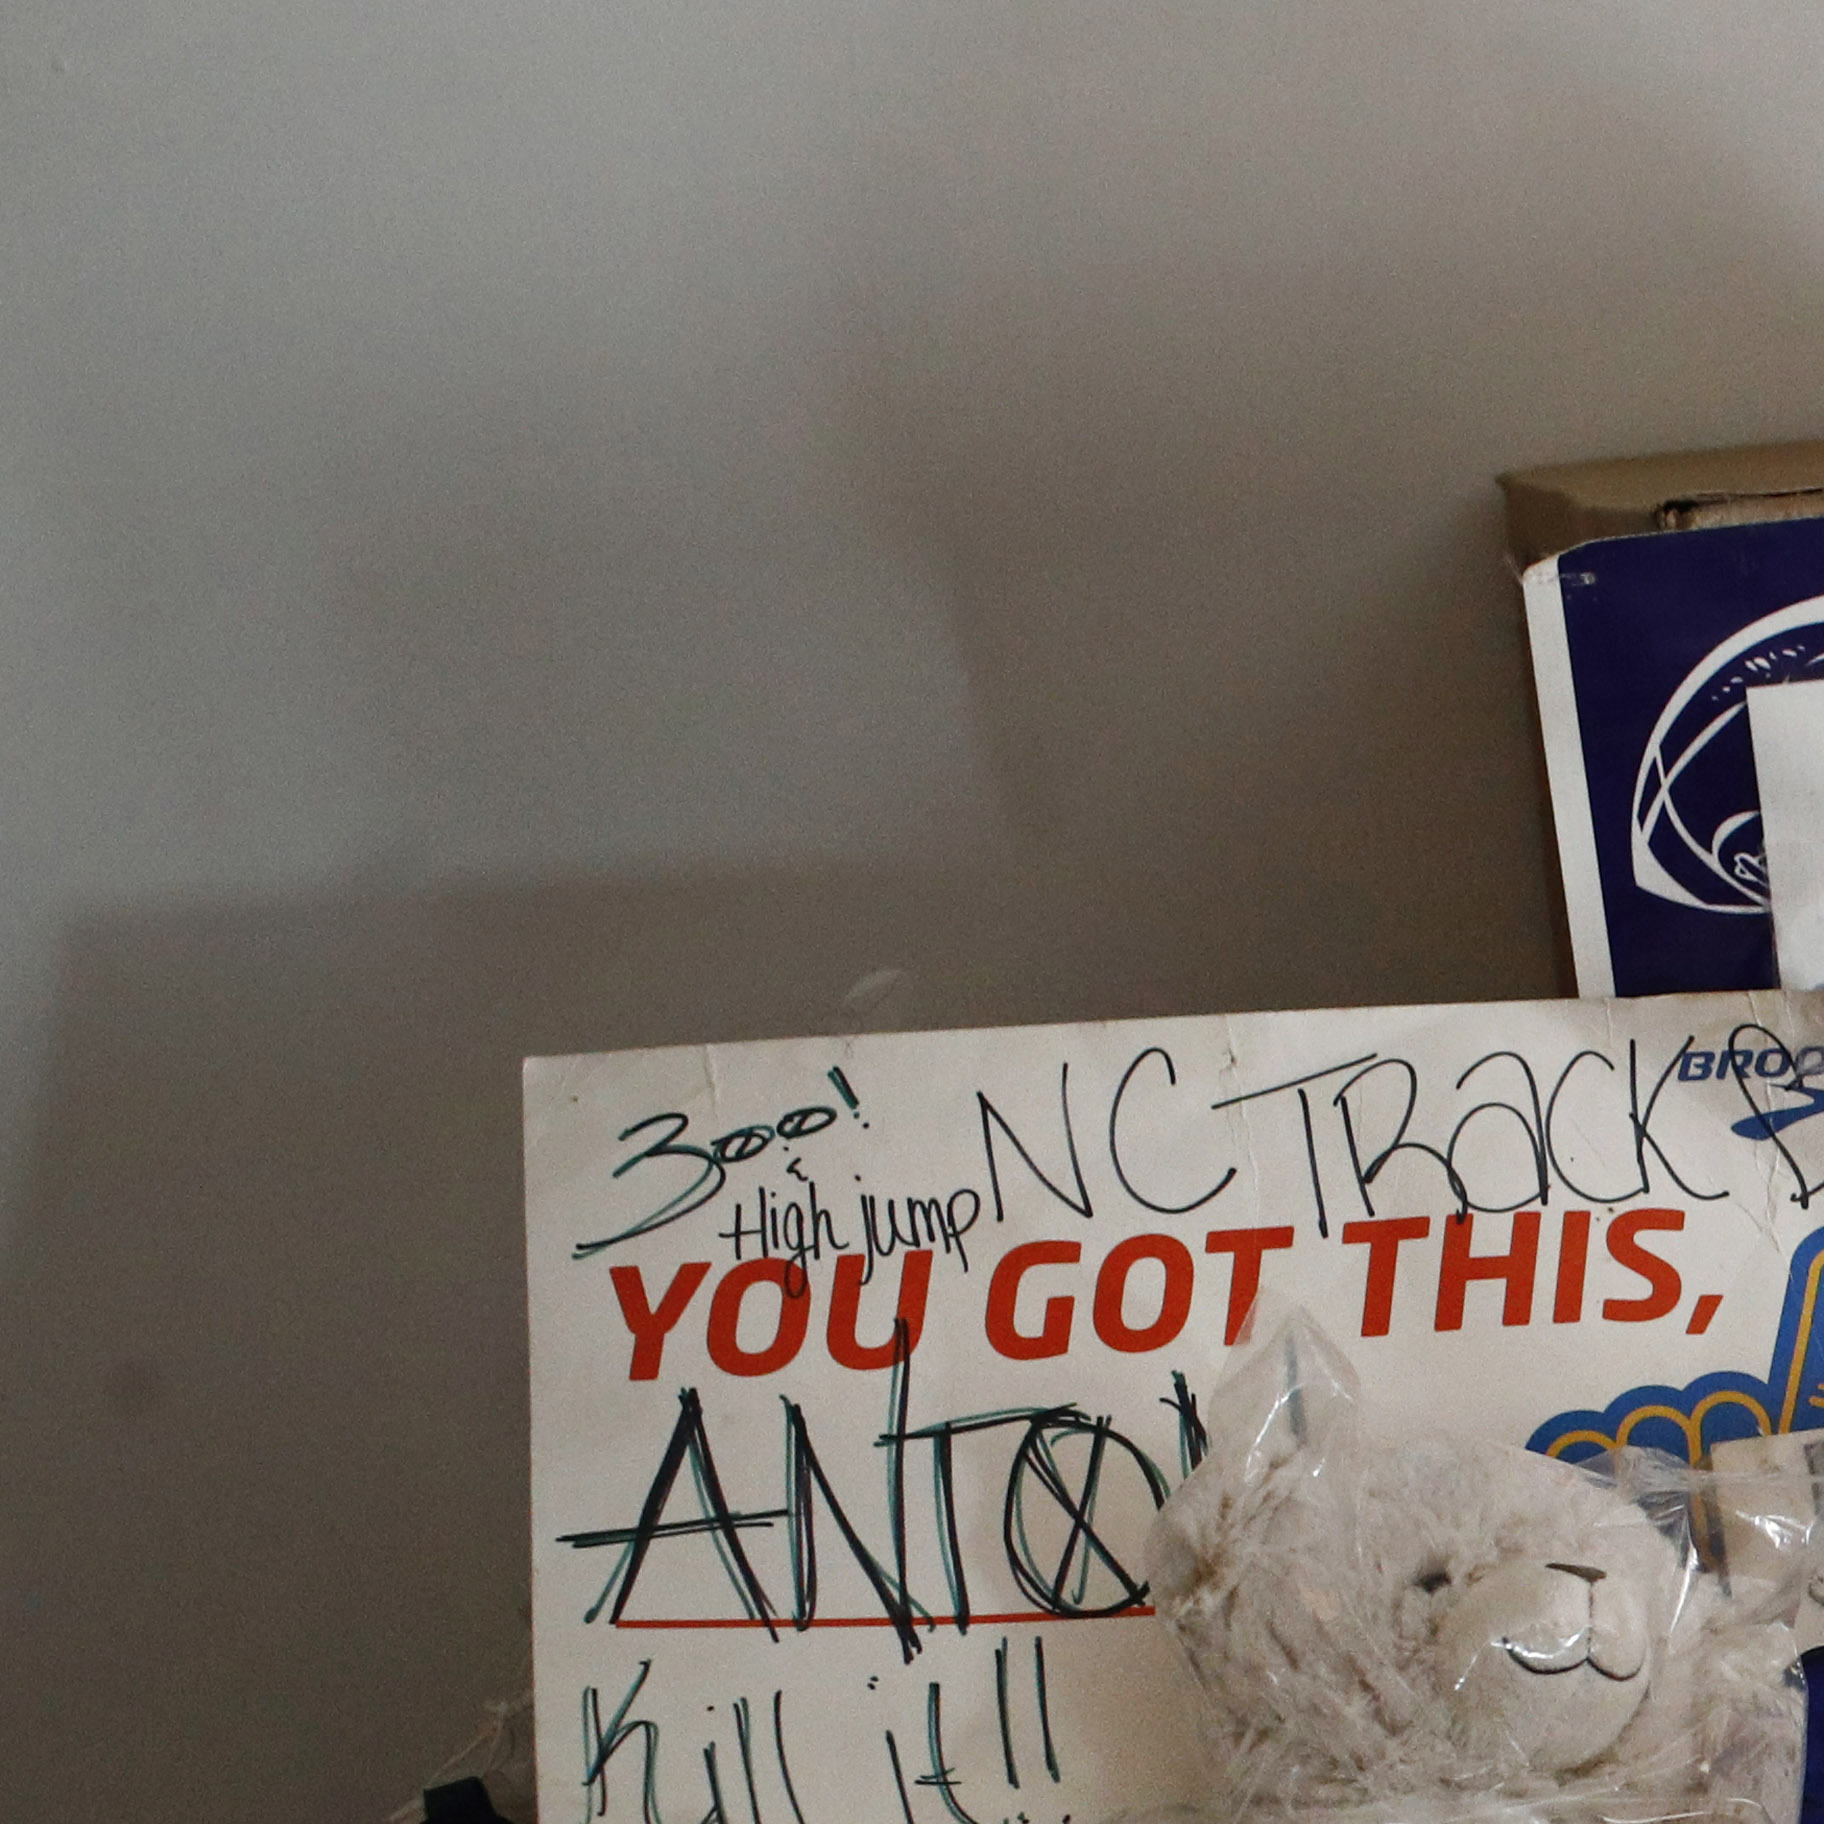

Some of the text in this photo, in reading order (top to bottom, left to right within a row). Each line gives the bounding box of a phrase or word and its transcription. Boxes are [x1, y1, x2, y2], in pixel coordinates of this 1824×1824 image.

[978, 1047, 1236, 1220] NC
[609, 1207, 1726, 1380] YOU GOT THIS,
[718, 1175, 982, 1299] High jump
[556, 1320, 1208, 1663] ANTO
